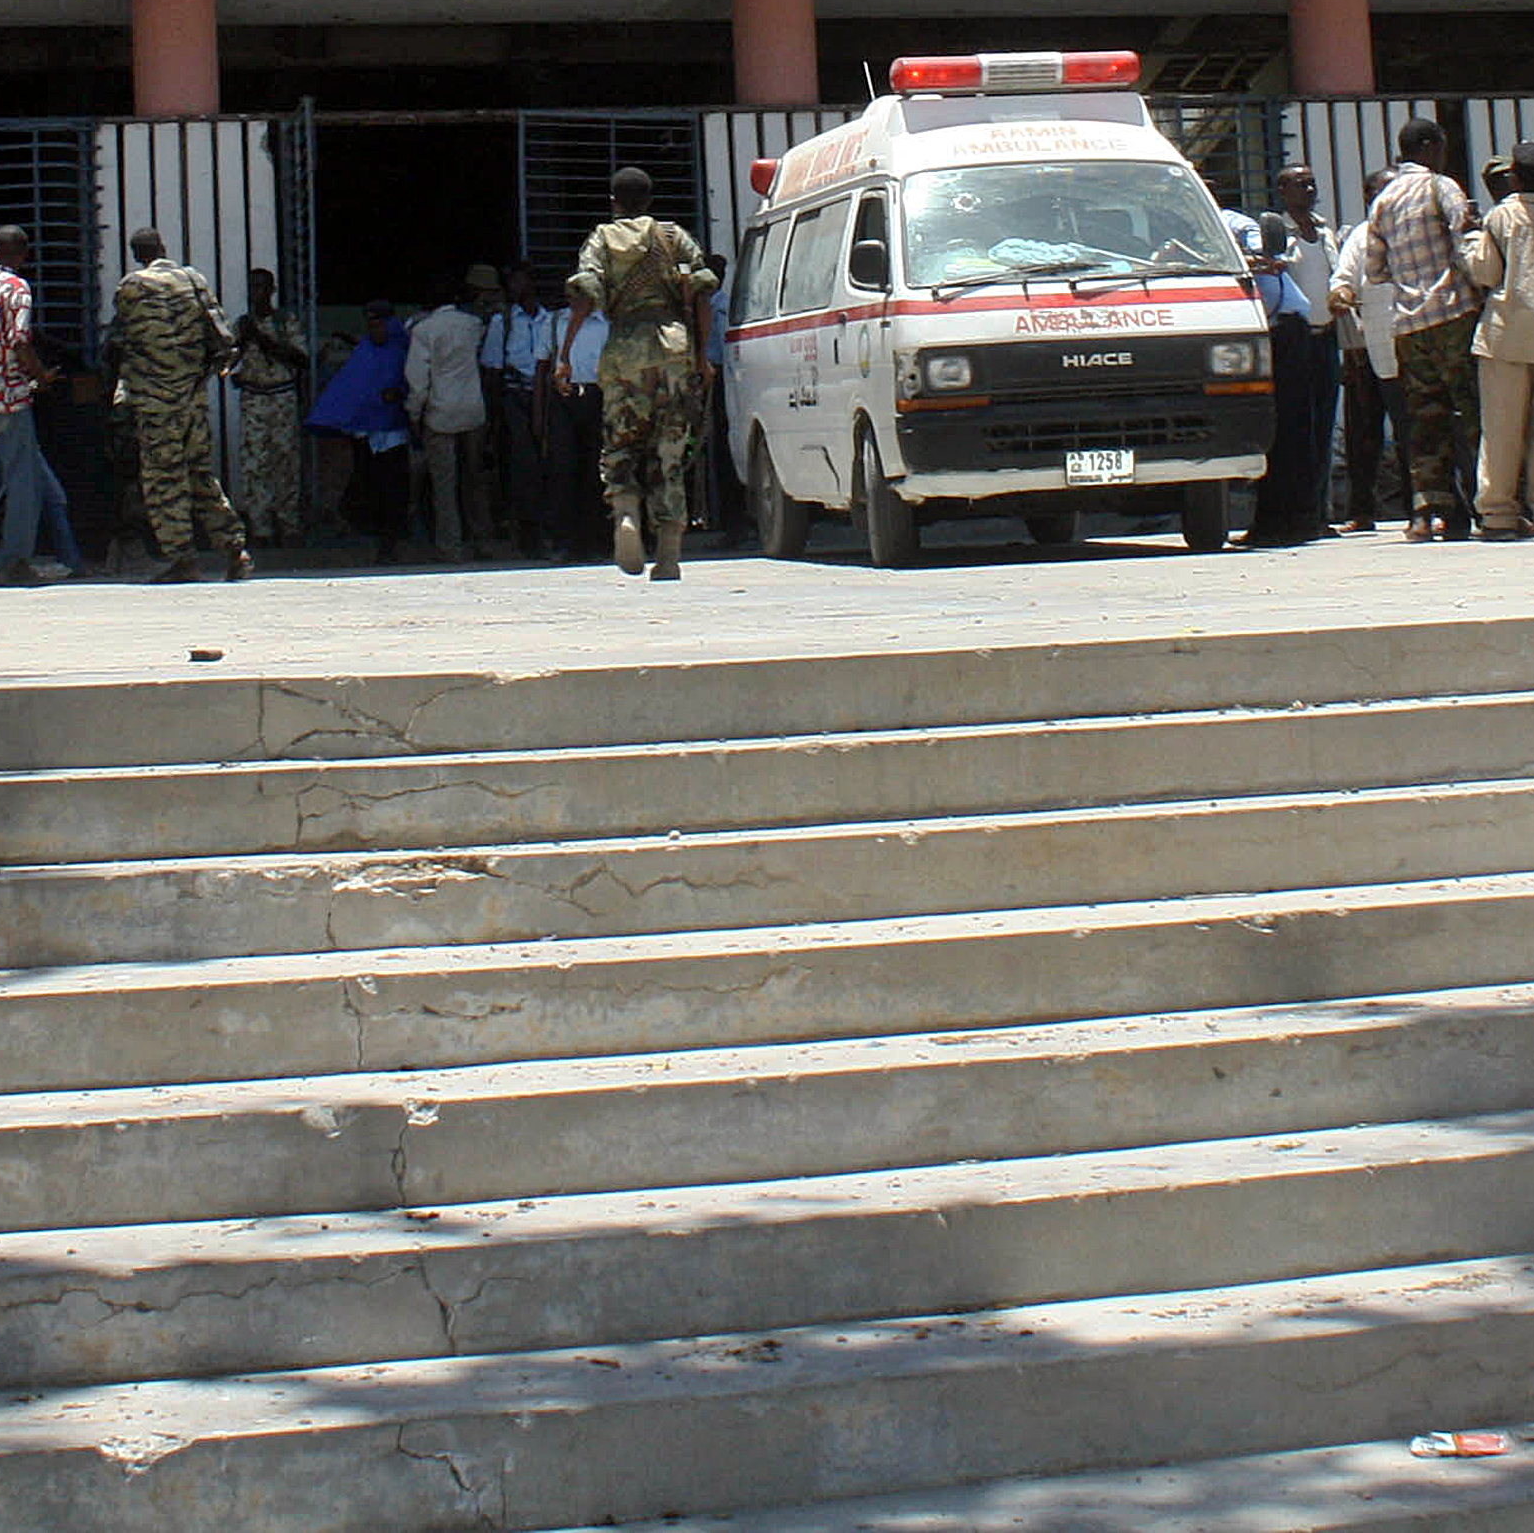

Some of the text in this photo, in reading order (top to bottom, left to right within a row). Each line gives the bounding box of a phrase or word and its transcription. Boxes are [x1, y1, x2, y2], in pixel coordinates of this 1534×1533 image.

[1014, 309, 1175, 334] AMBULANCE
[1061, 352, 1134, 368] HIACE
[1088, 452, 1123, 471] 1258
